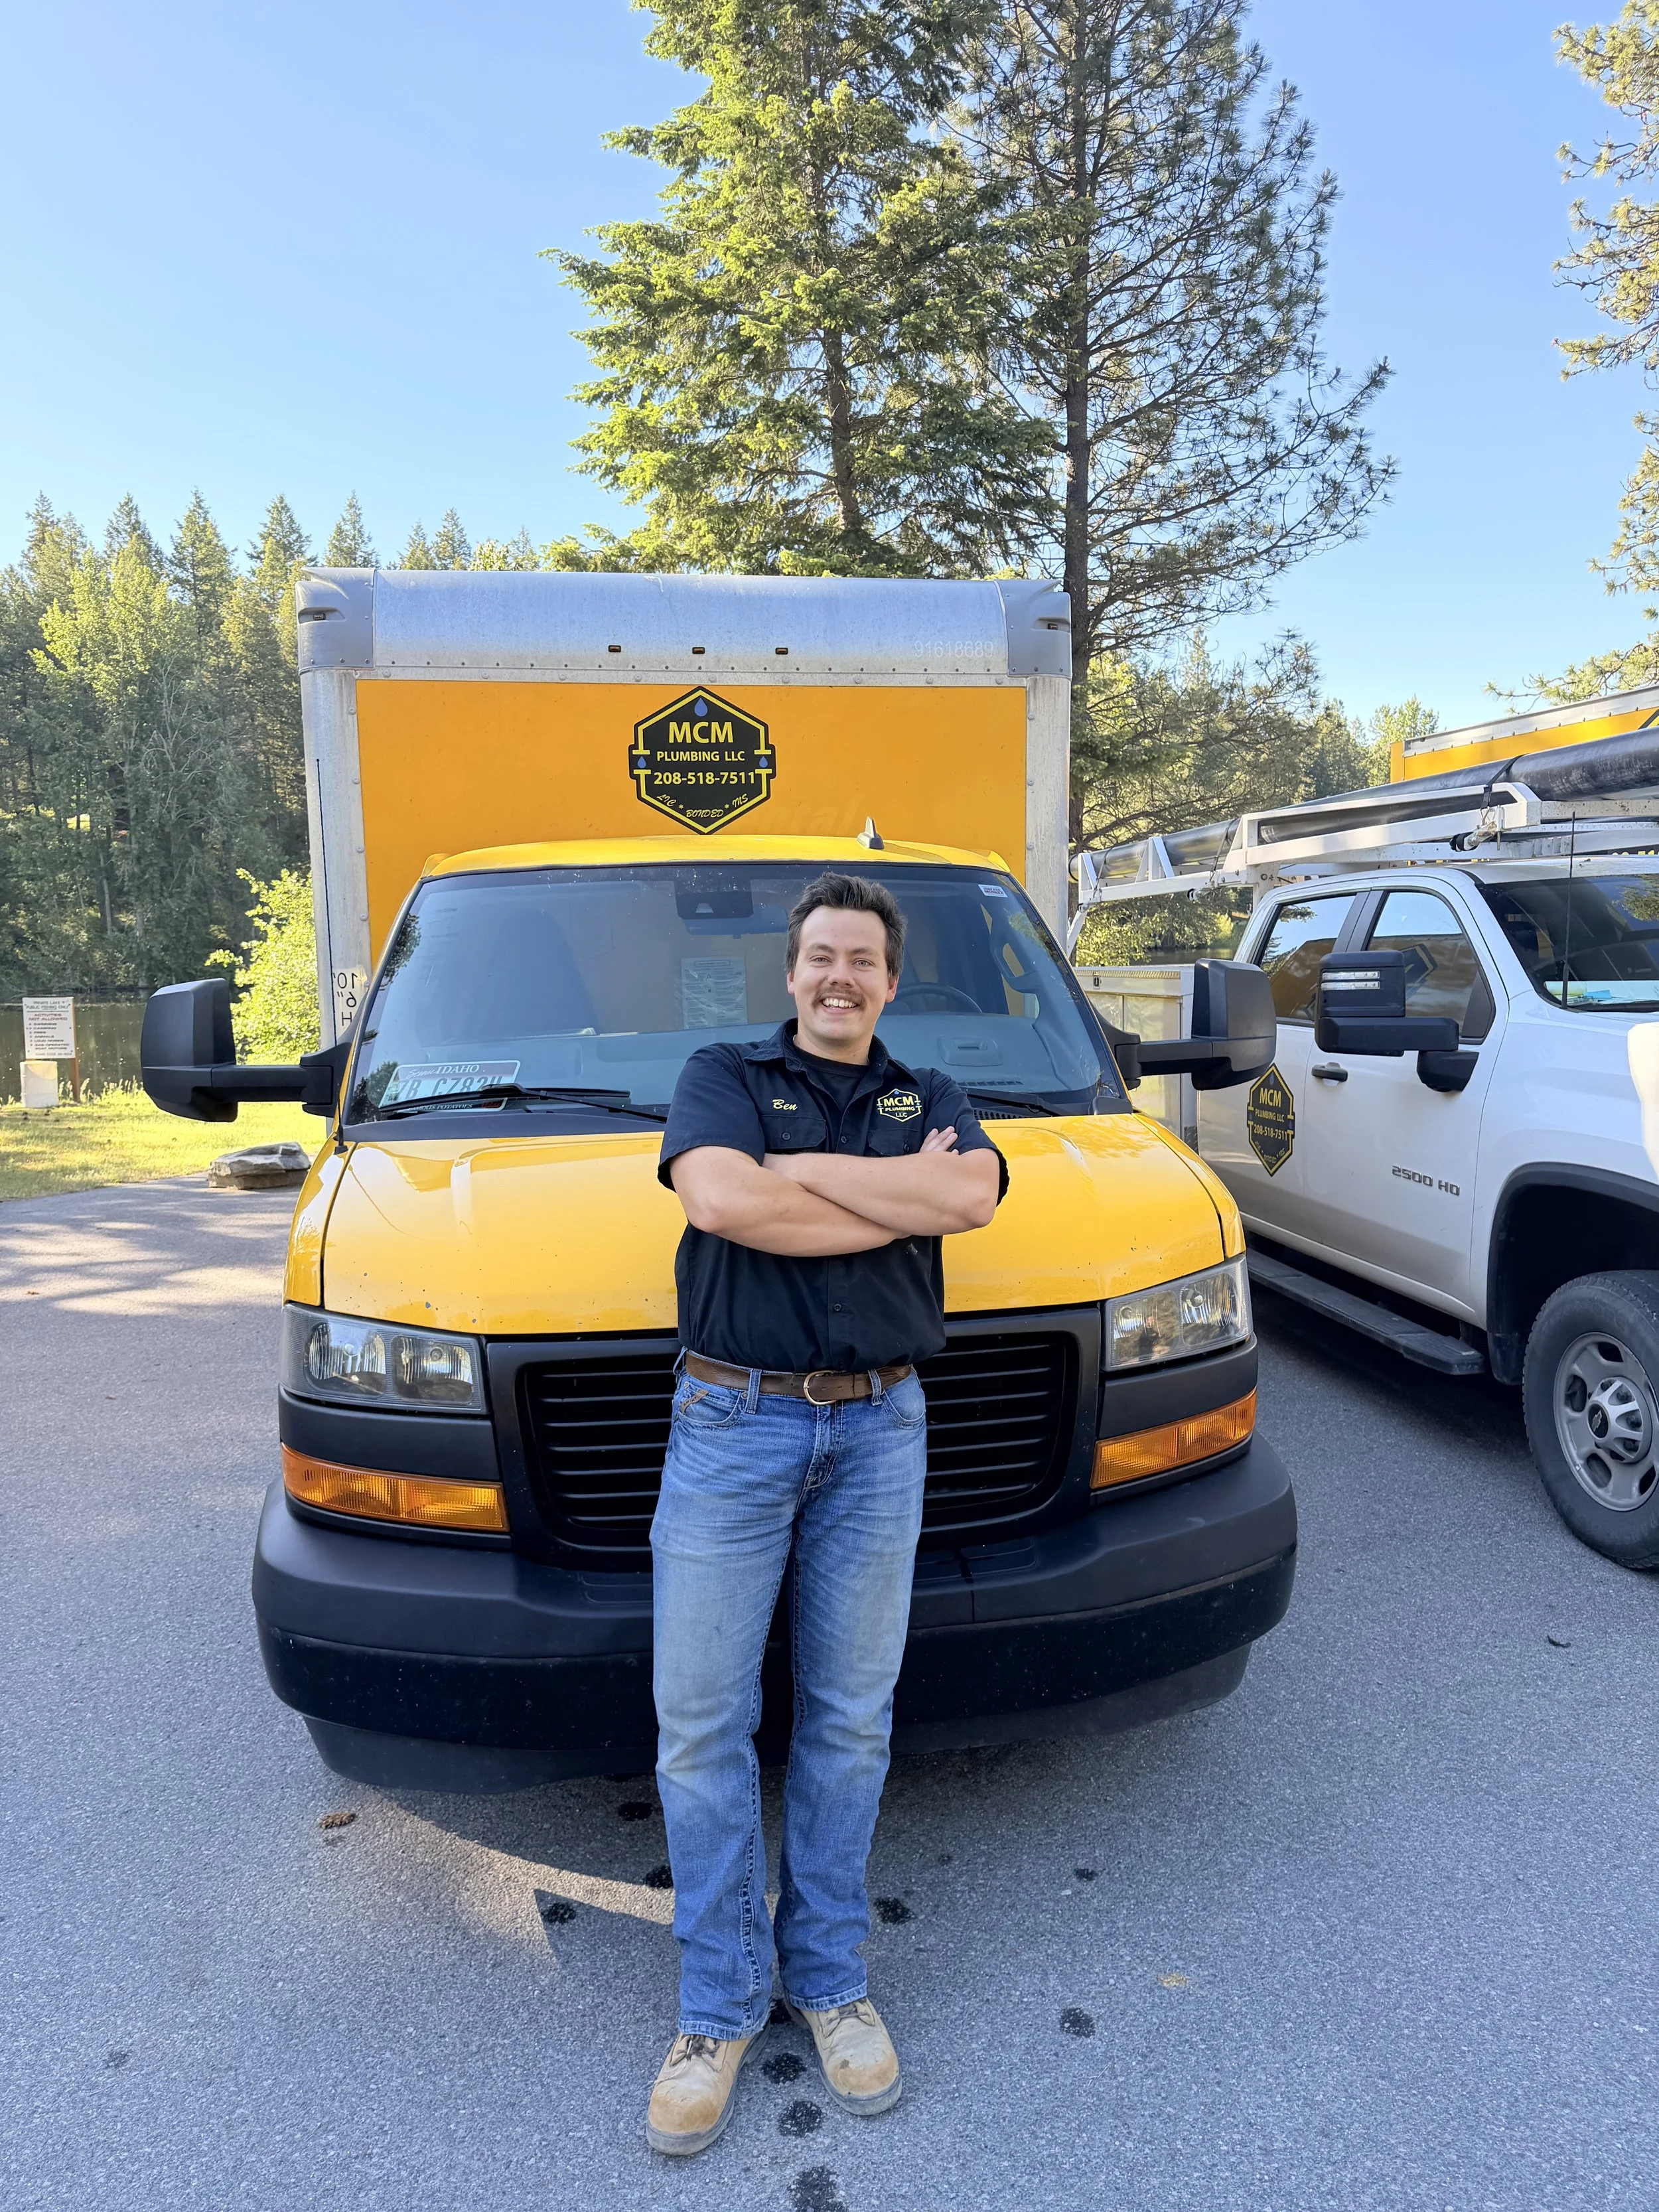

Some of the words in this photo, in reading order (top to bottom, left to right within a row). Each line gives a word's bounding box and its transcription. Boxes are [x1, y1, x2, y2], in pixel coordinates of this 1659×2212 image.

[668, 721, 733, 743] MCM
[656, 751, 720, 761] PLUMBING
[725, 751, 745, 761] LLC
[654, 771, 755, 784] 208-518-7511
[436, 1065, 480, 1074] IDAHO
[772, 1099, 798, 1110] Ben
[883, 1096, 914, 1107] MCM
[1259, 1088, 1282, 1108] MCM
[1255, 1108, 1276, 1122] PLUMBING
[1254, 1124, 1288, 1141] 208-518-7511
[1392, 1165, 1433, 1187] 2500
[1438, 1179, 1461, 1197] HD
